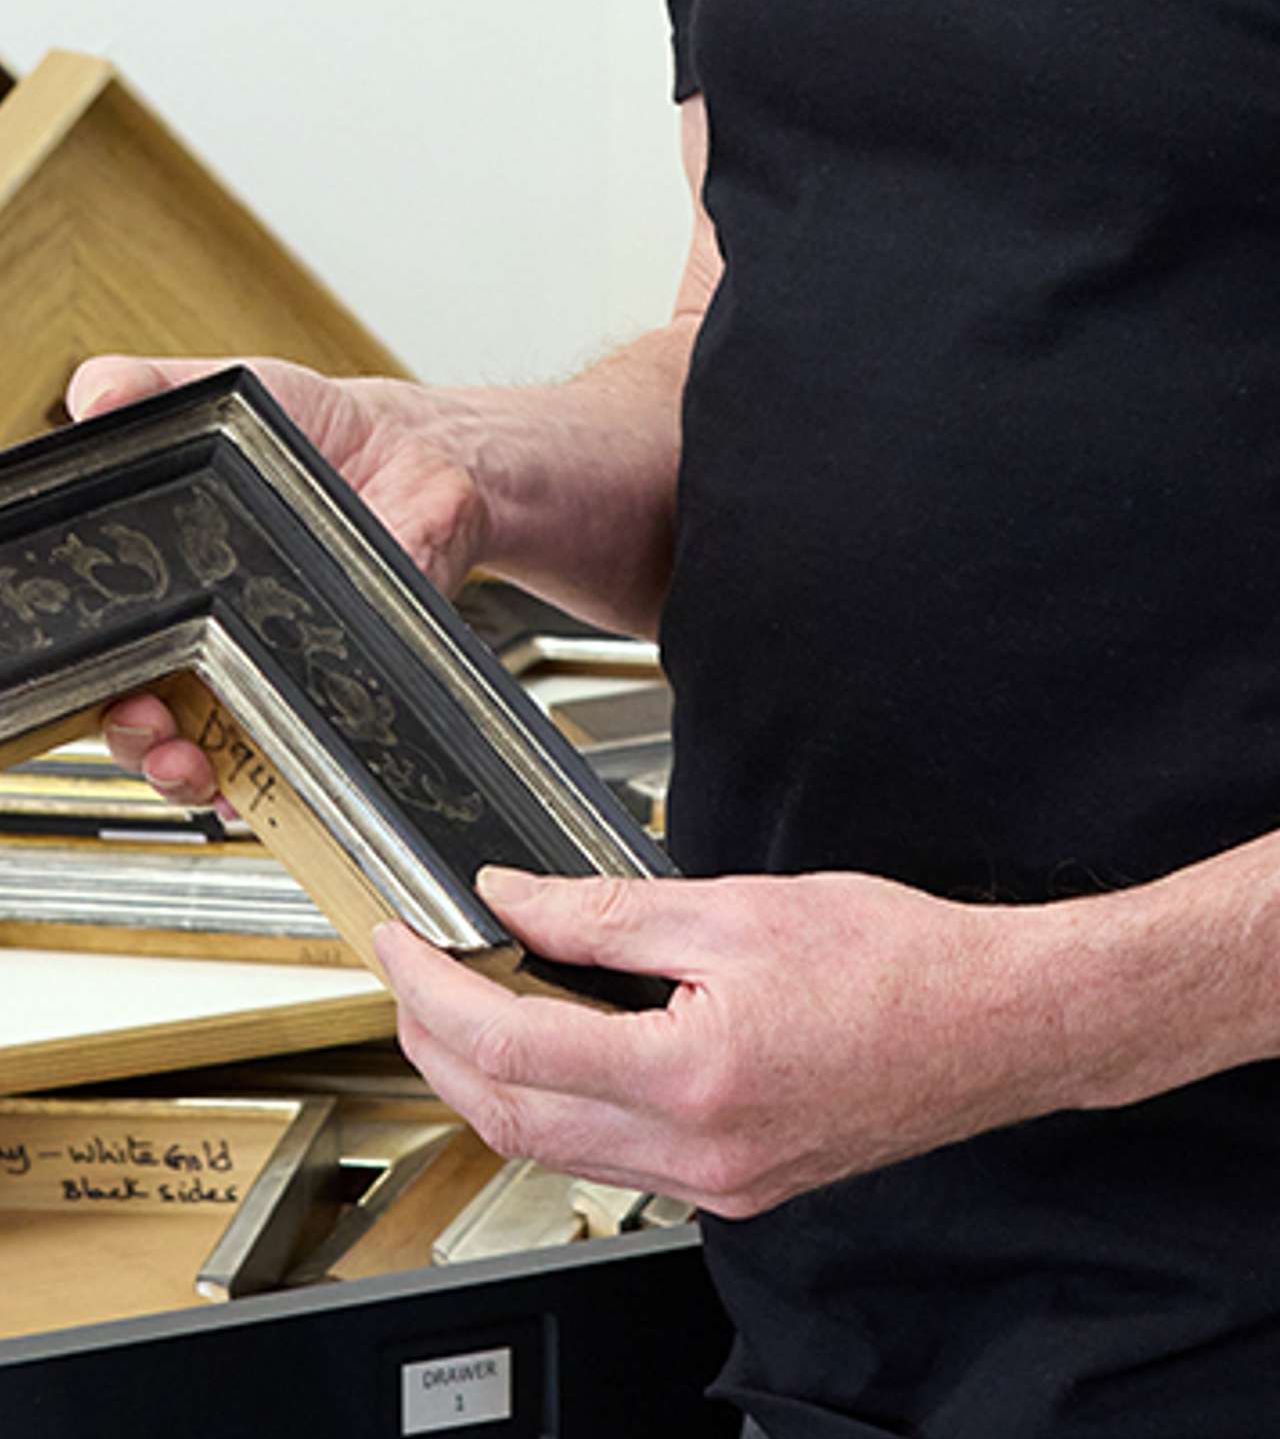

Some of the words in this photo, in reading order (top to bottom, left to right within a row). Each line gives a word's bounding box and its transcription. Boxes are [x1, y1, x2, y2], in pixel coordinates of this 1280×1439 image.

[163, 1139, 233, 1171] Gold
[62, 1176, 149, 1201] Black
[157, 1177, 238, 1203] sides
[422, 1359, 497, 1390] DRAWER
